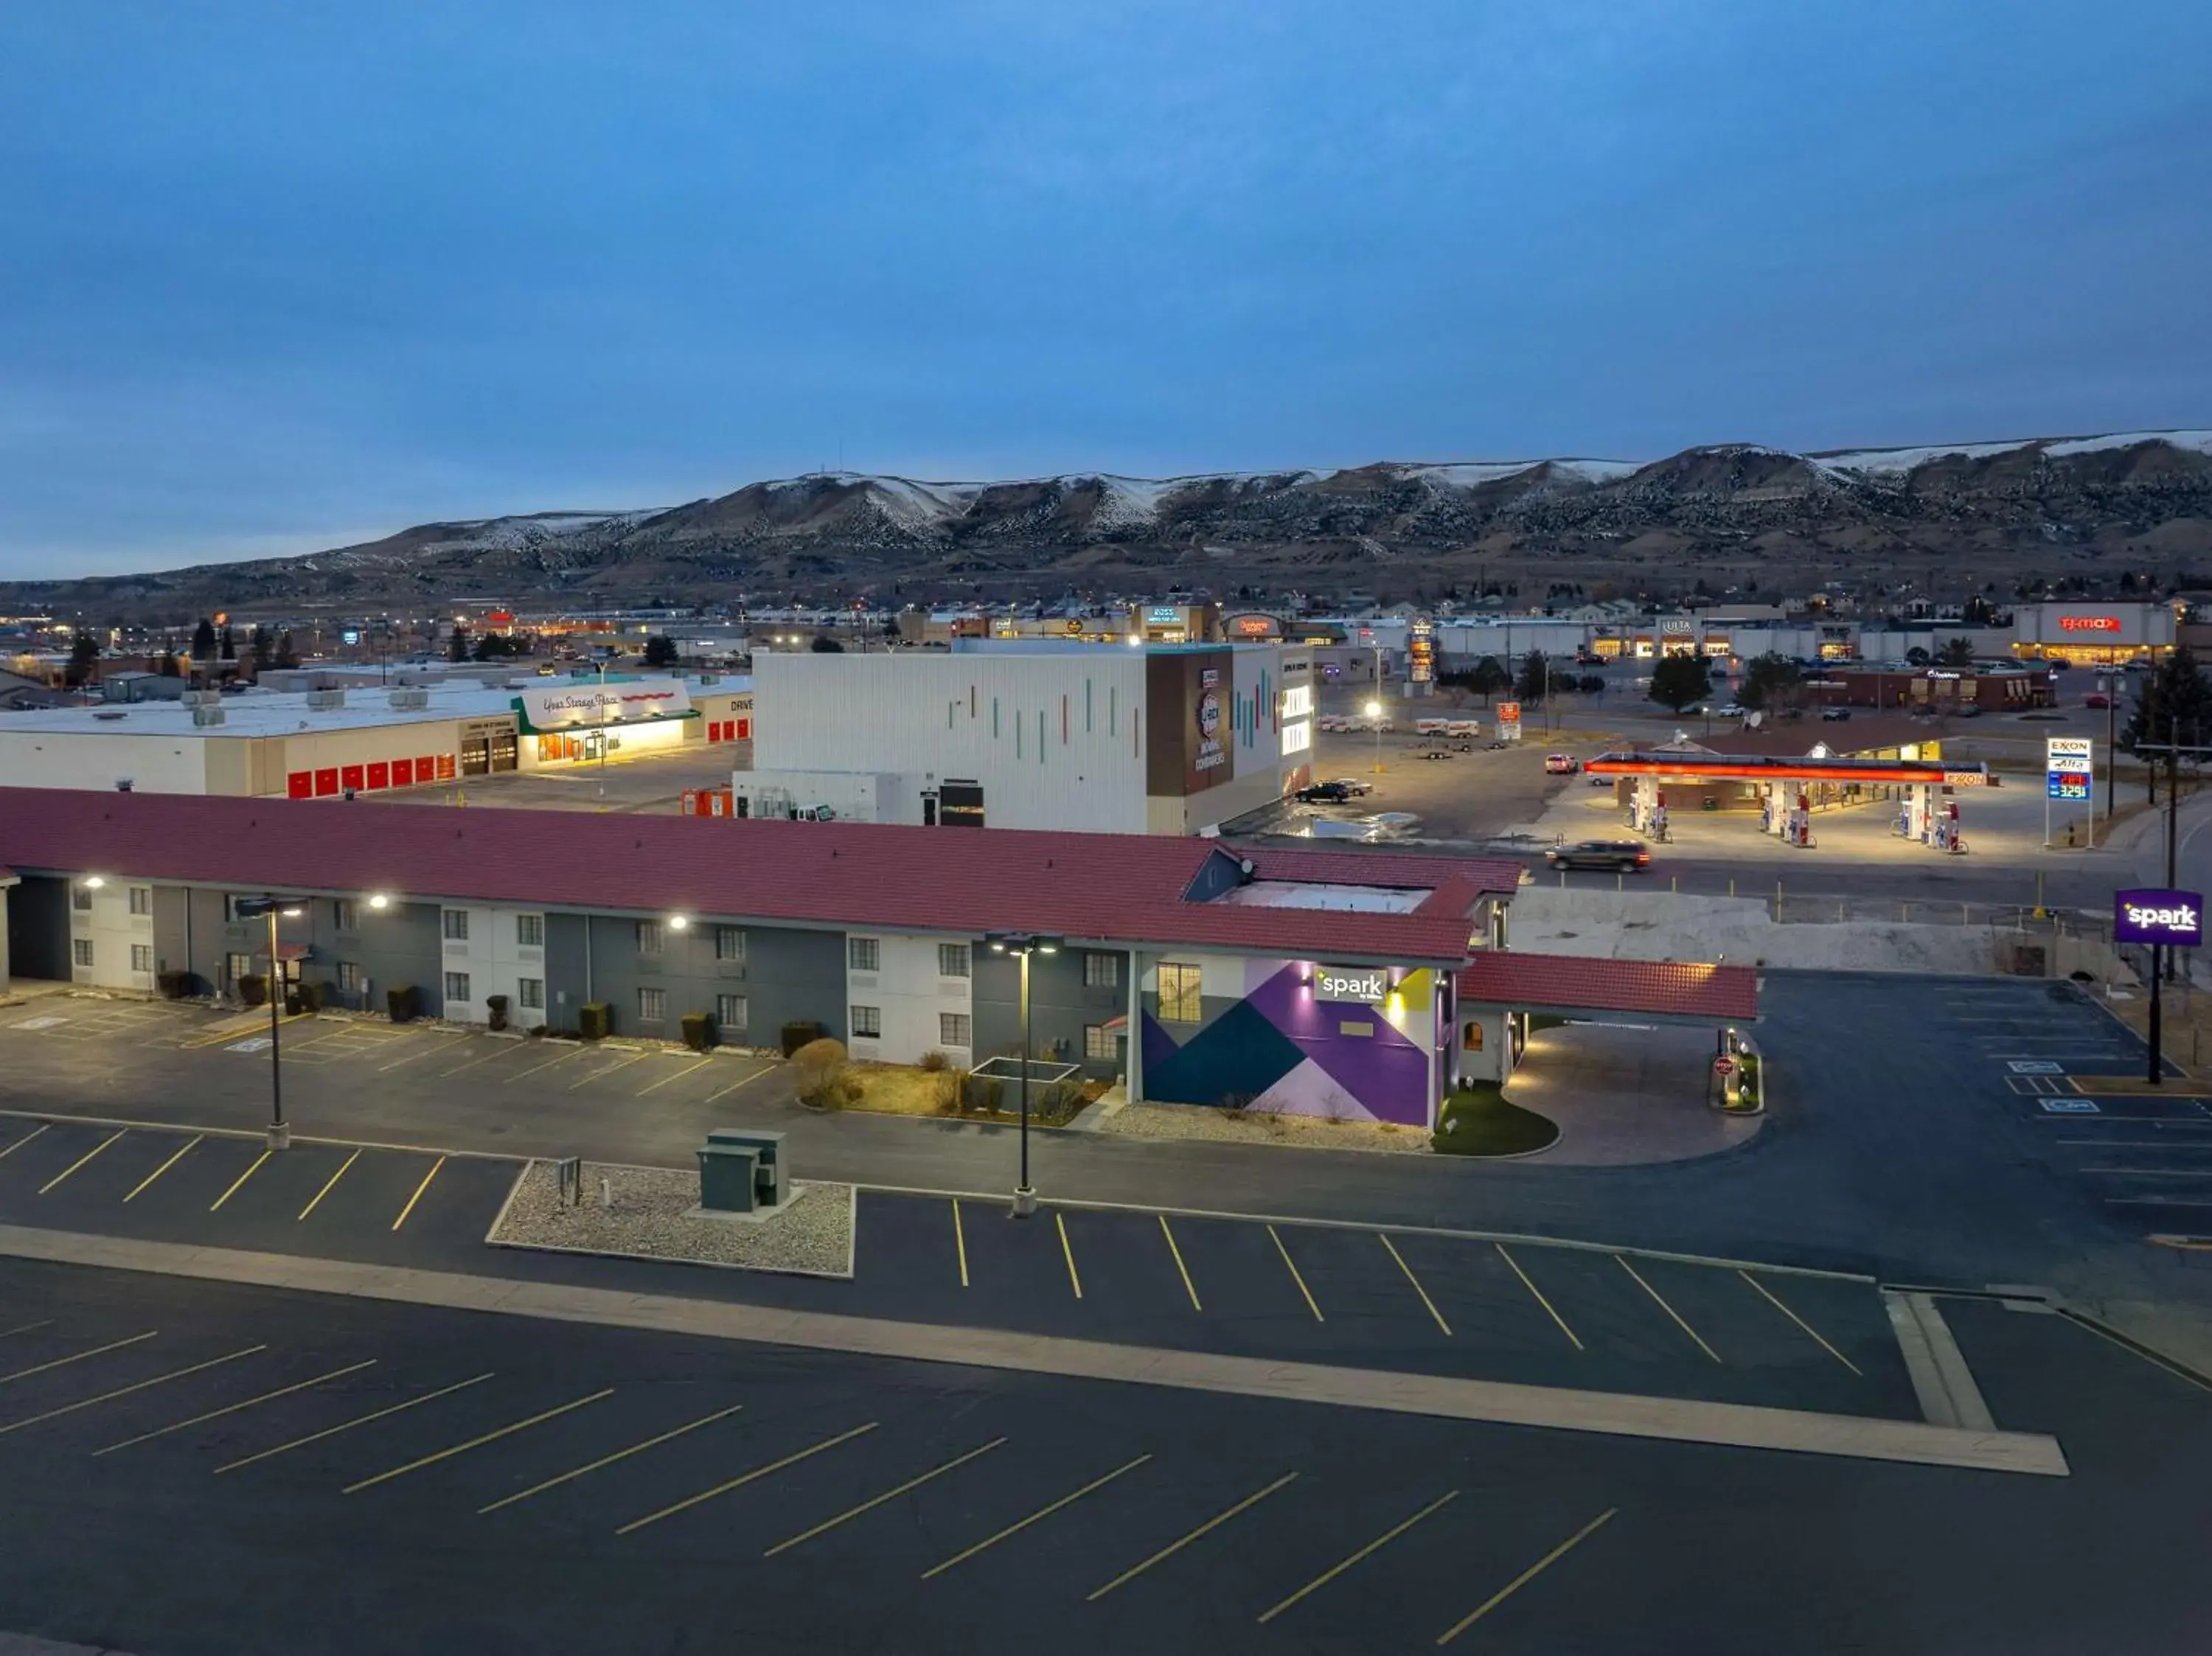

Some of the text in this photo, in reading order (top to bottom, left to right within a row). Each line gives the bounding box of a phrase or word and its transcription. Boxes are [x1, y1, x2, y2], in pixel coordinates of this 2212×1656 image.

[2052, 741, 2087, 752] EXXON
[1948, 774, 1986, 787] EXXON
[2129, 905, 2197, 928] spark
[1323, 974, 1382, 997] spark
